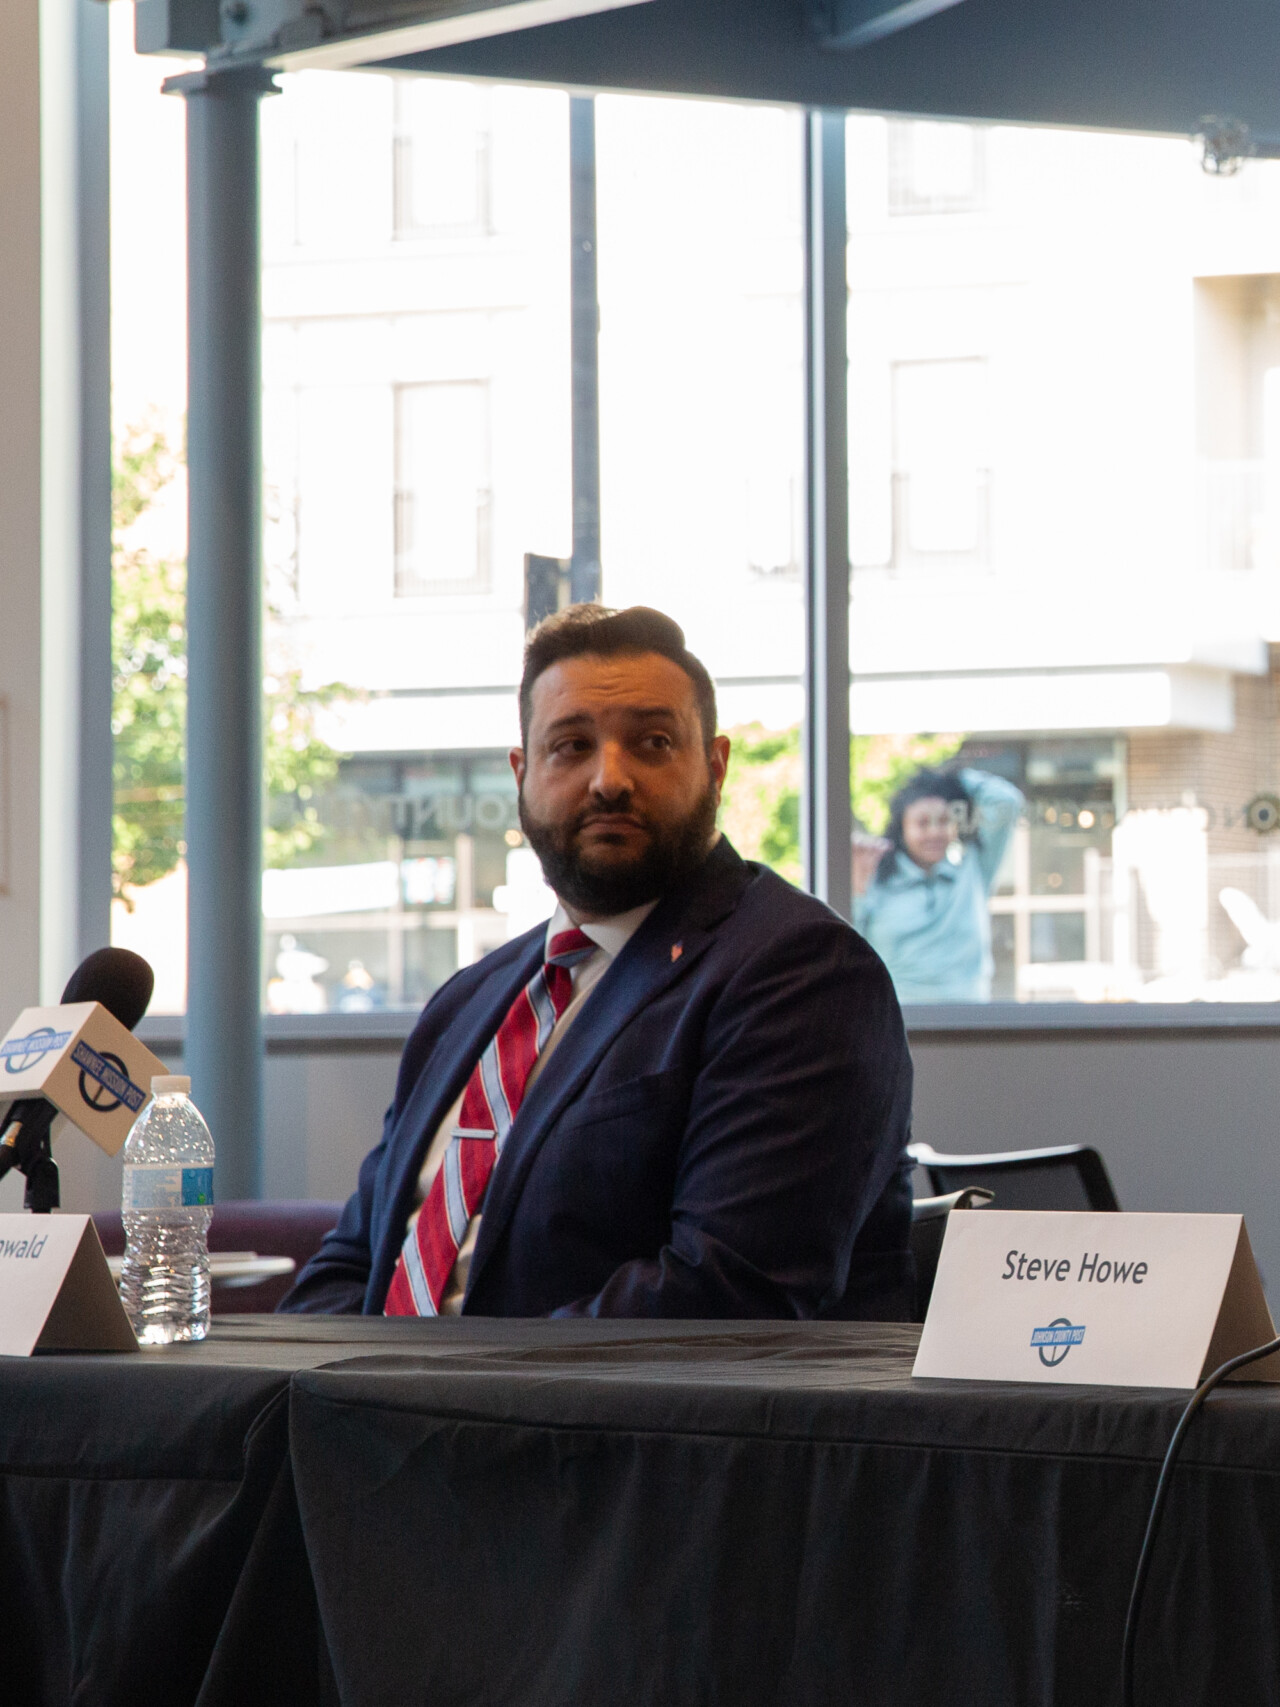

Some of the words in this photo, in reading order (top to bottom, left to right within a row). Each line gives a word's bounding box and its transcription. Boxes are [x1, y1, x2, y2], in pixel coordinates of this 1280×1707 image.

[73, 1044, 106, 1077] SHAWNEE
[99, 1065, 130, 1097] MISSION
[124, 1085, 145, 1111] POST
[1001, 1250, 1071, 1282] Steve
[1077, 1252, 1149, 1285] Howe
